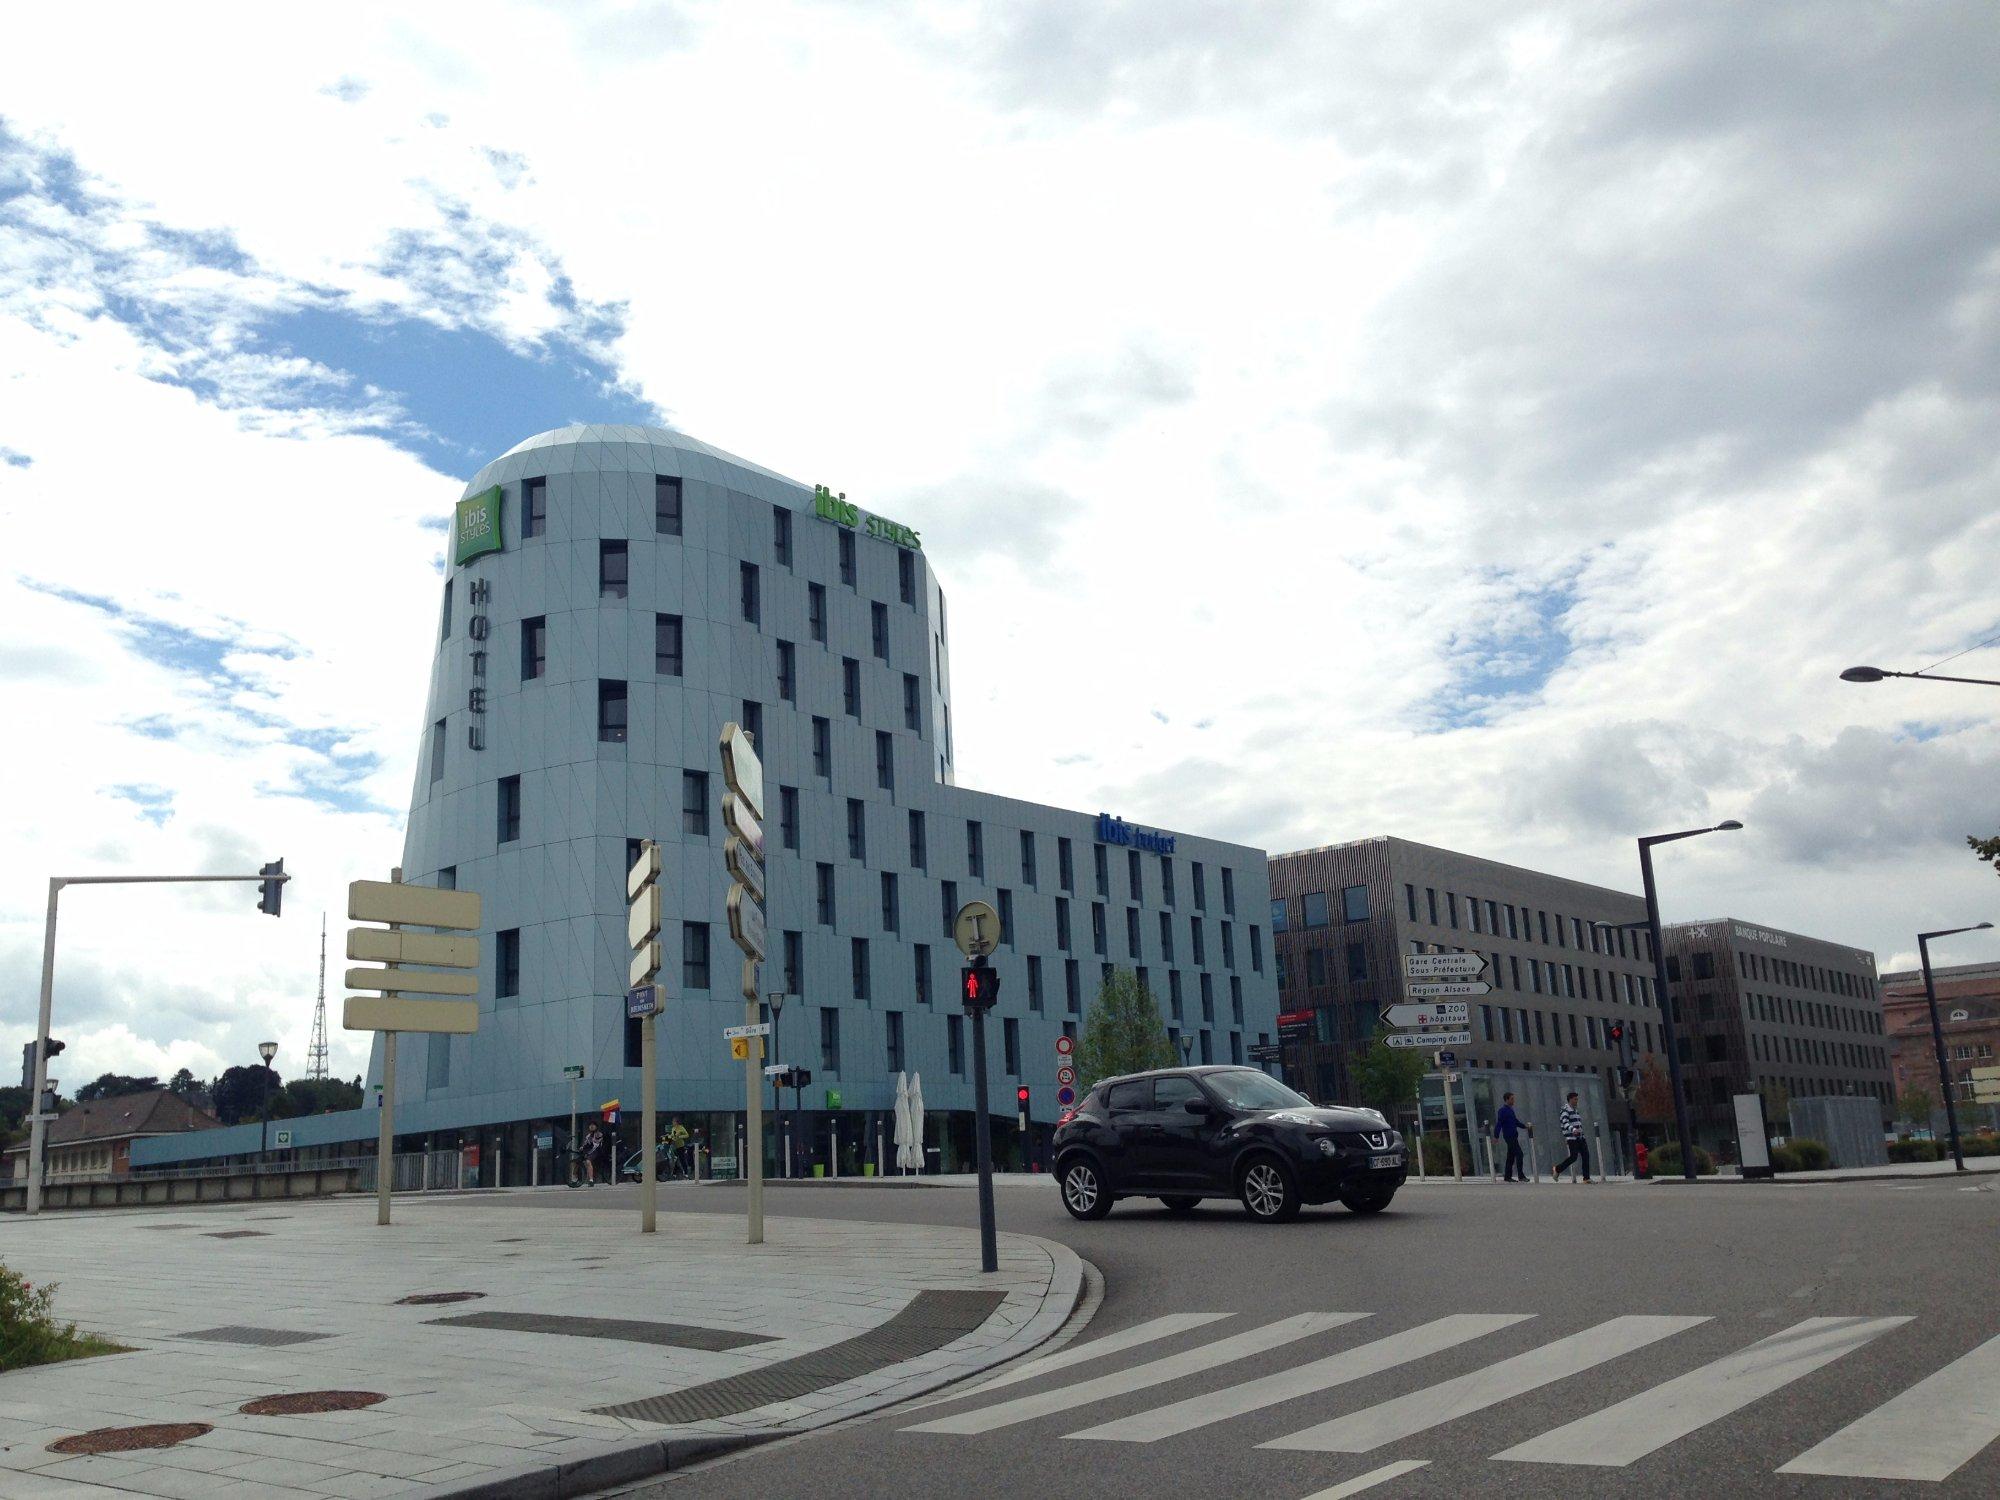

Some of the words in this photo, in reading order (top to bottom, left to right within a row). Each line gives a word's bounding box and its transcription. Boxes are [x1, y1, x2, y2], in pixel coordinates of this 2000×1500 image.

[464, 505, 487, 529] ibis
[815, 483, 859, 528] ibis
[469, 577, 492, 751] HOTEL
[1099, 812, 1130, 846] ibis
[1735, 925, 1758, 941] BANQUE
[1759, 930, 1787, 948] POPULAIRE
[1431, 957, 1466, 965] Centrale
[1443, 985, 1471, 993] Alsace
[1416, 1035, 1447, 1045] Camping
[1448, 1034, 1458, 1042] de
